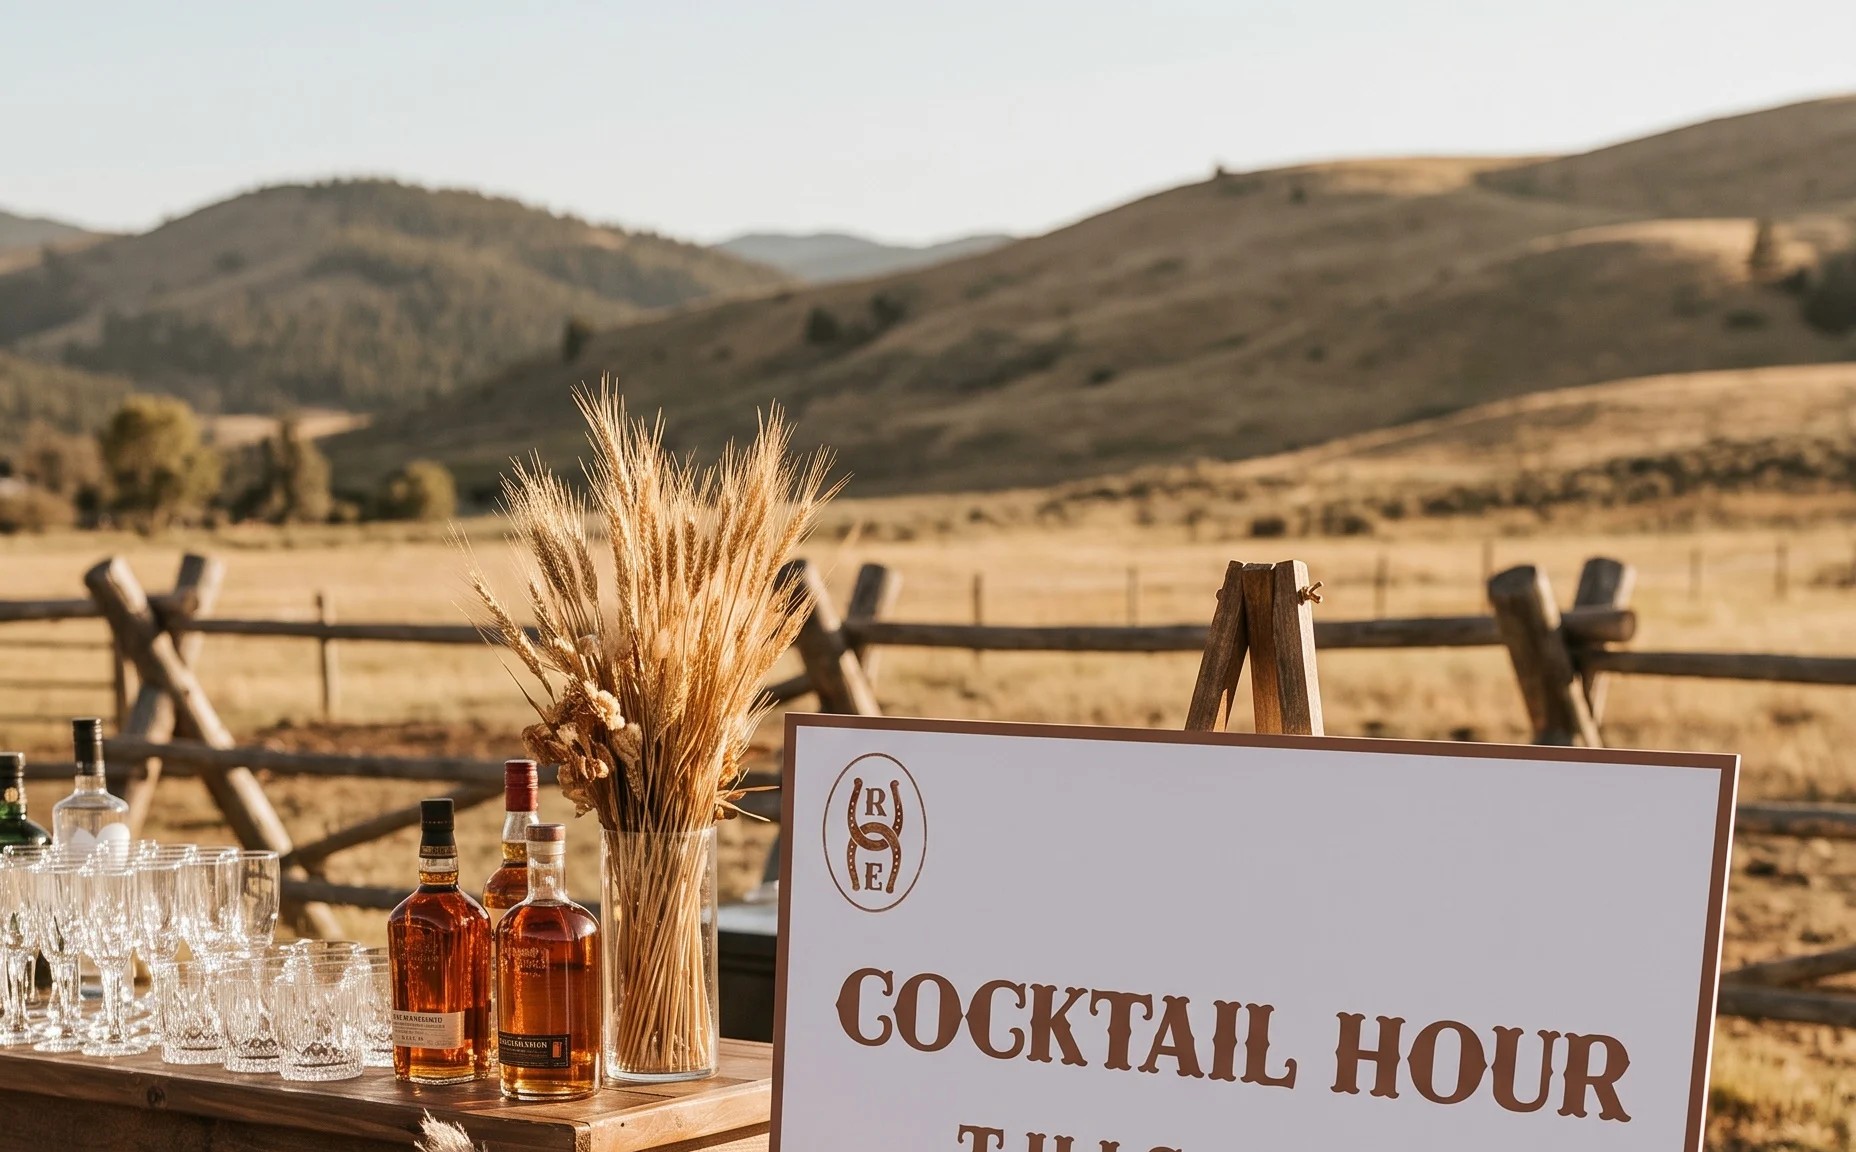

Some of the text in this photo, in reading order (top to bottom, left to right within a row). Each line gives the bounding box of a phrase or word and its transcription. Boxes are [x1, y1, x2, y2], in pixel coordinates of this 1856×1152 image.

[865, 788, 887, 817] R
[865, 862, 883, 891] E
[835, 967, 1632, 1123] COCKTAIL HOUR
